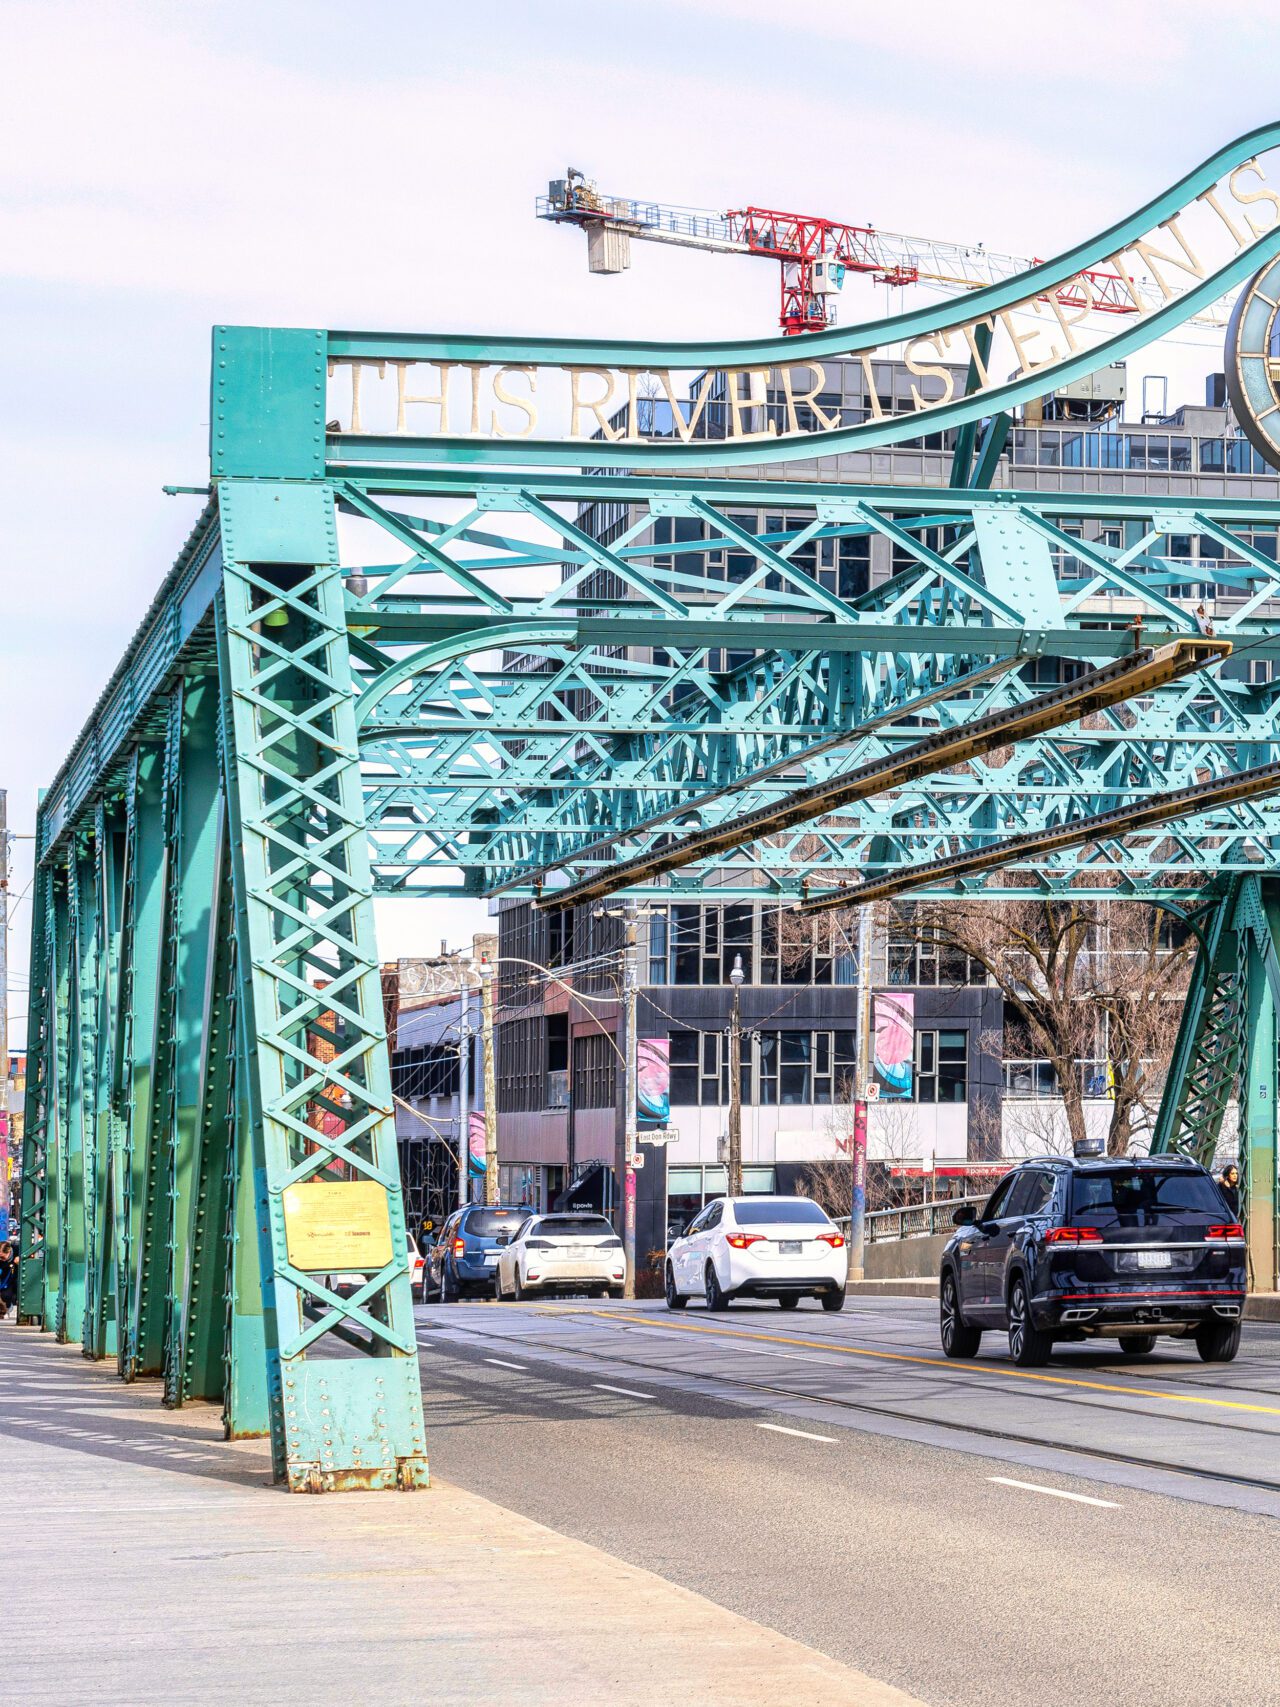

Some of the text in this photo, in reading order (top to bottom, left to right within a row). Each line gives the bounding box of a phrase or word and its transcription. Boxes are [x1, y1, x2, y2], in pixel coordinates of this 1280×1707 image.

[327, 360, 538, 438] THIS
[561, 363, 842, 443] RIVER
[850, 347, 894, 420] I
[904, 279, 1094, 412] STEP
[1102, 211, 1206, 315] IN
